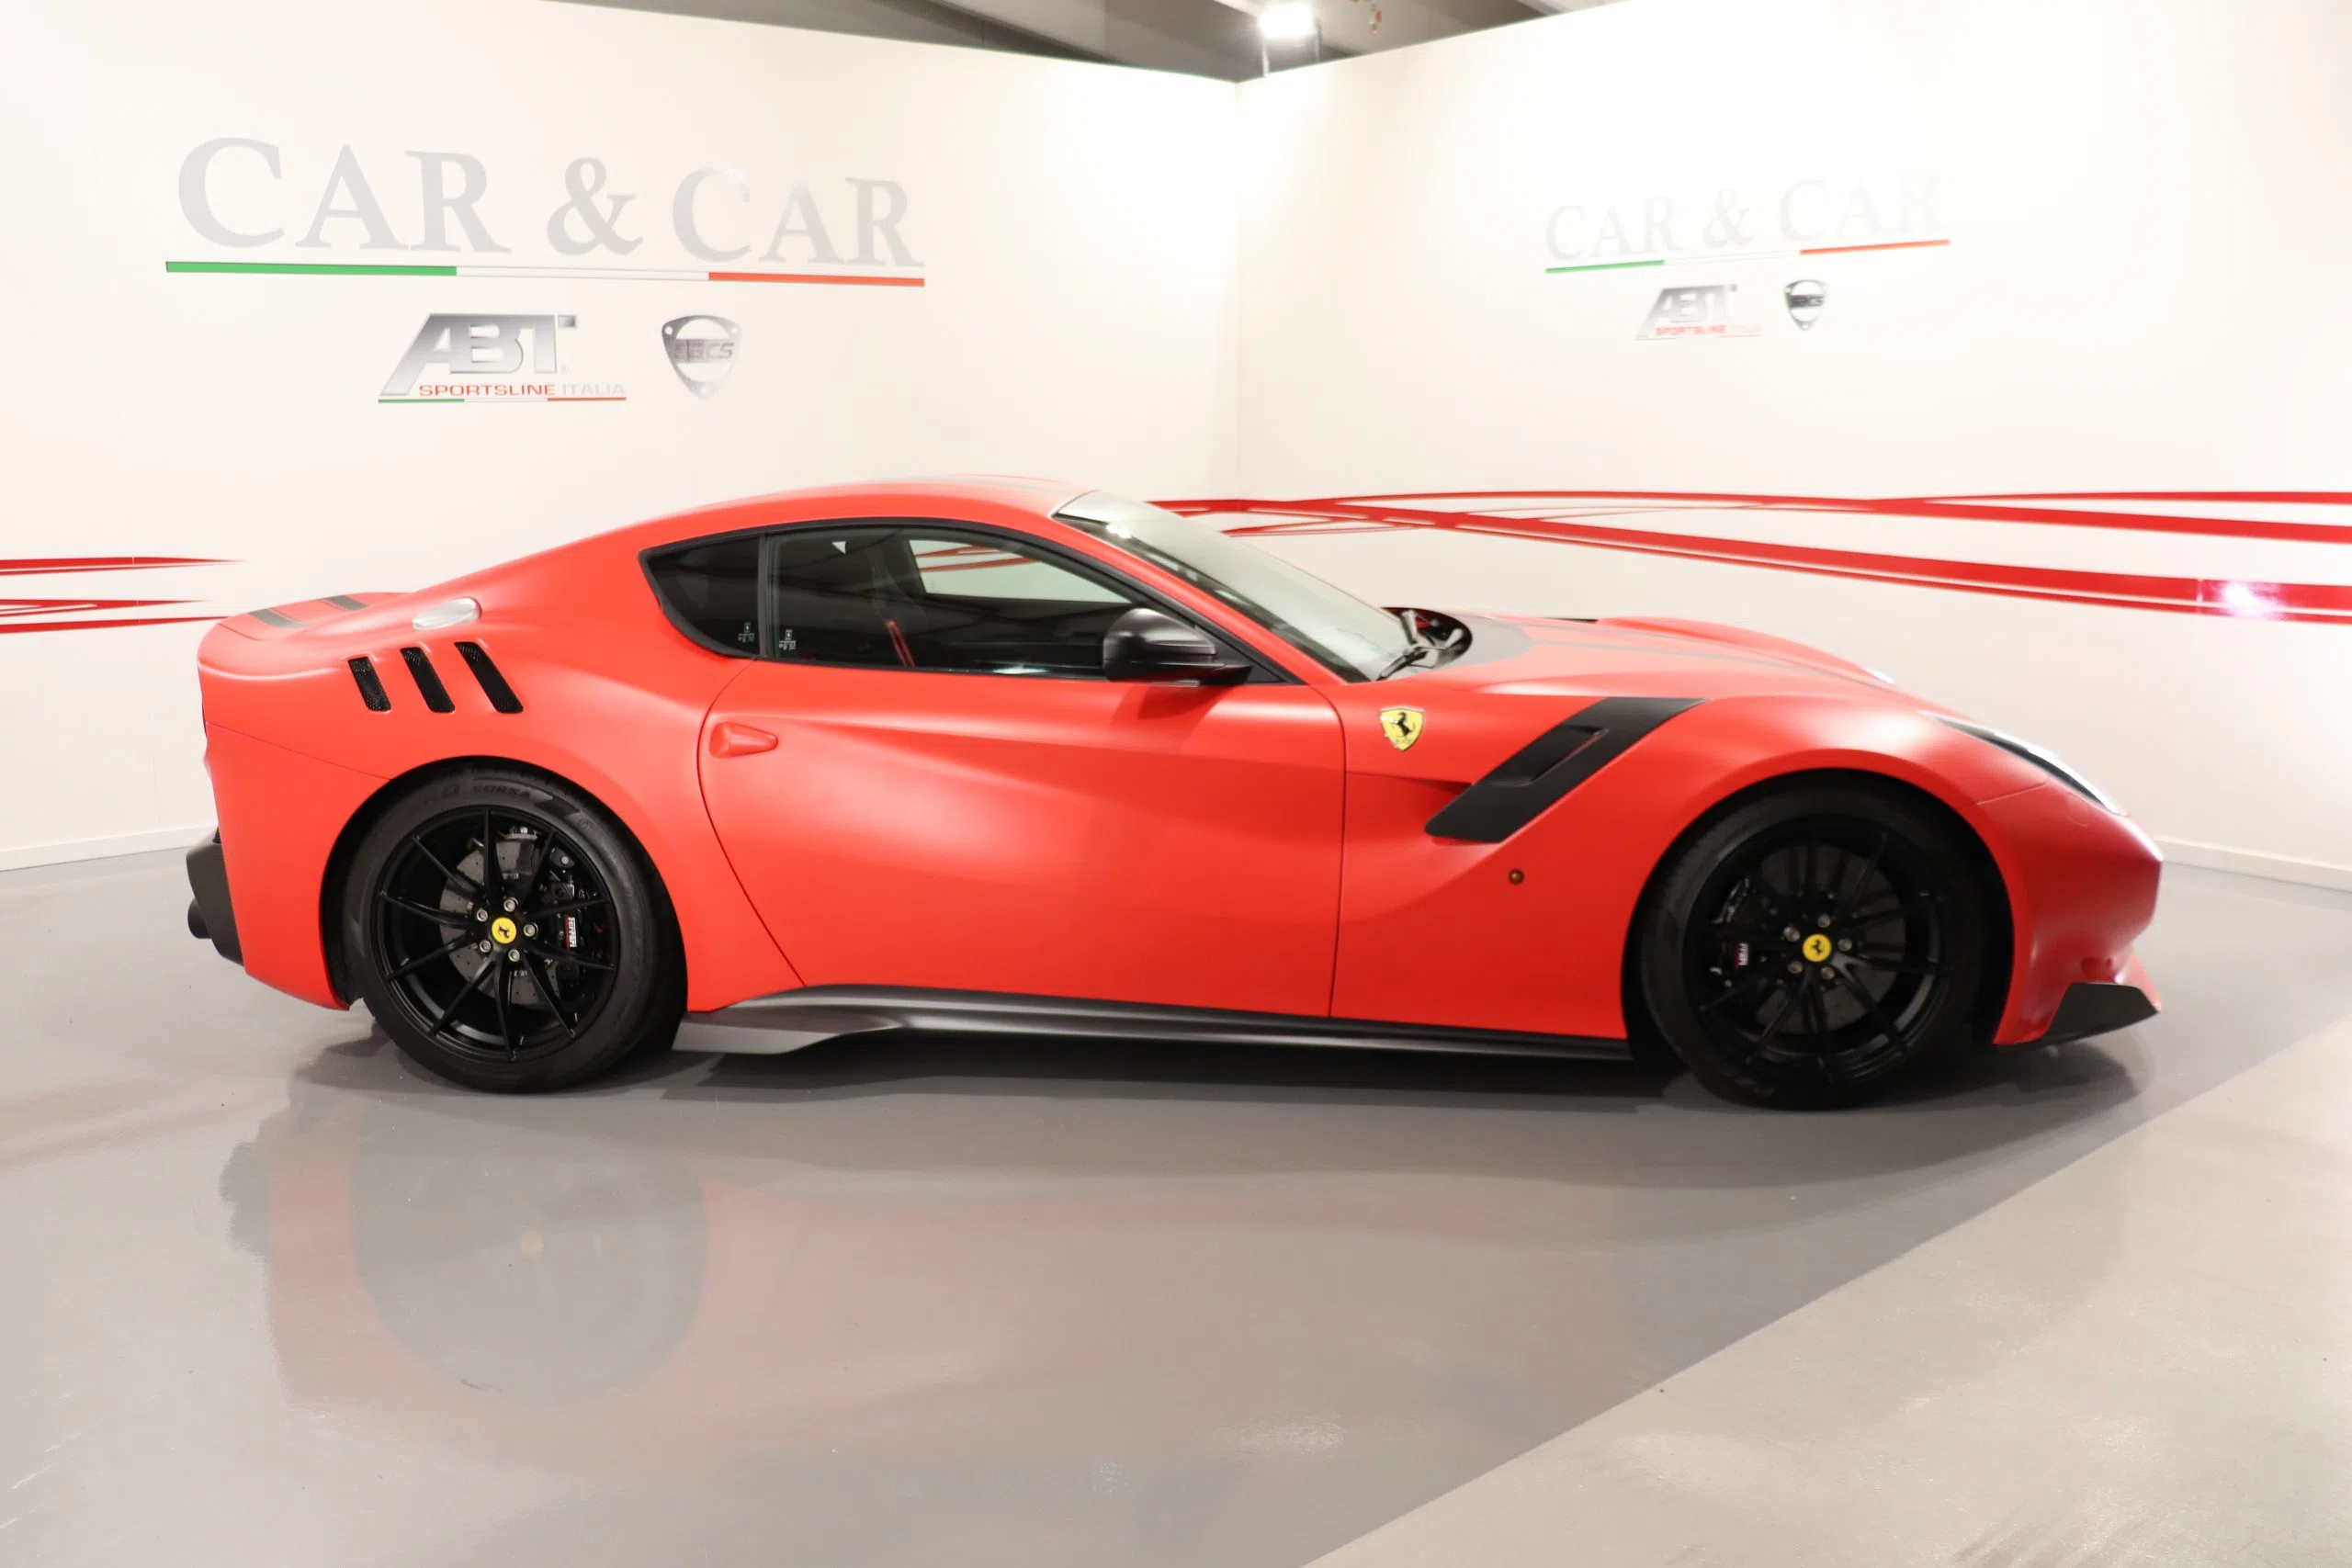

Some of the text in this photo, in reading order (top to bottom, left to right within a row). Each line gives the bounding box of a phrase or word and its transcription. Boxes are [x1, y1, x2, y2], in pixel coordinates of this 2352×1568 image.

[178, 137, 925, 267] CAR & CAR
[1544, 169, 1942, 261] CAR & CAR
[1636, 284, 1726, 338] ABT
[380, 313, 557, 396] ABT
[419, 383, 627, 397] SPORTSLINE ITALIA
